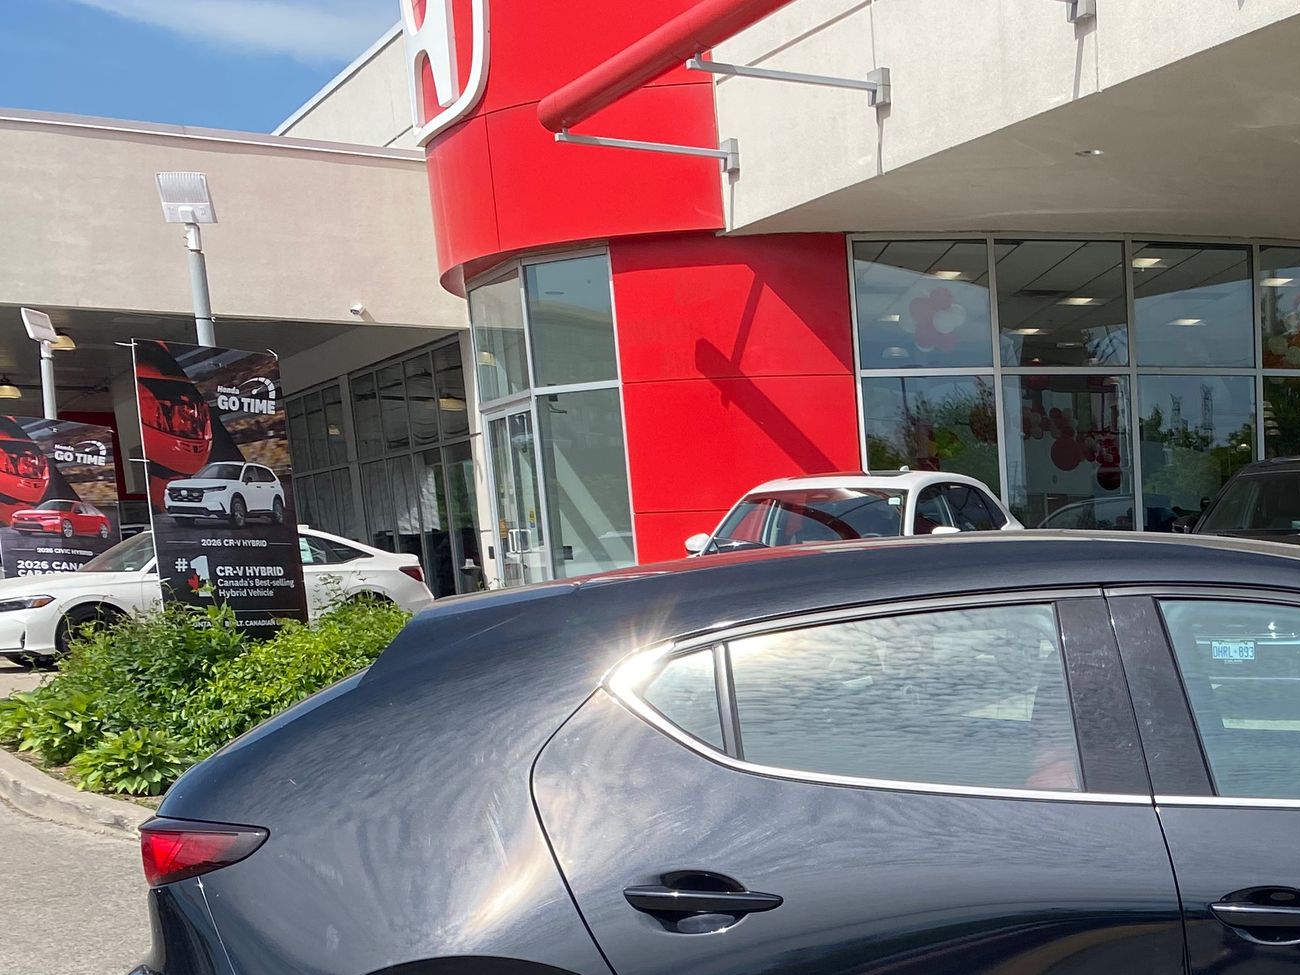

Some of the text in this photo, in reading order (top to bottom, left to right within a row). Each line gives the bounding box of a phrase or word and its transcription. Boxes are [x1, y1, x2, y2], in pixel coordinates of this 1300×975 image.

[217, 385, 240, 395] Honda
[217, 395, 276, 415] GO TIME
[54, 450, 106, 466] GO TIME
[201, 539, 222, 547] 2026
[223, 539, 241, 547] CR-V
[17, 560, 49, 570] 2026
[216, 565, 284, 577] CR-V HYBRID
[217, 578, 295, 588] Canada's Best-selling
[219, 588, 274, 598] Hybrid Vehicle
